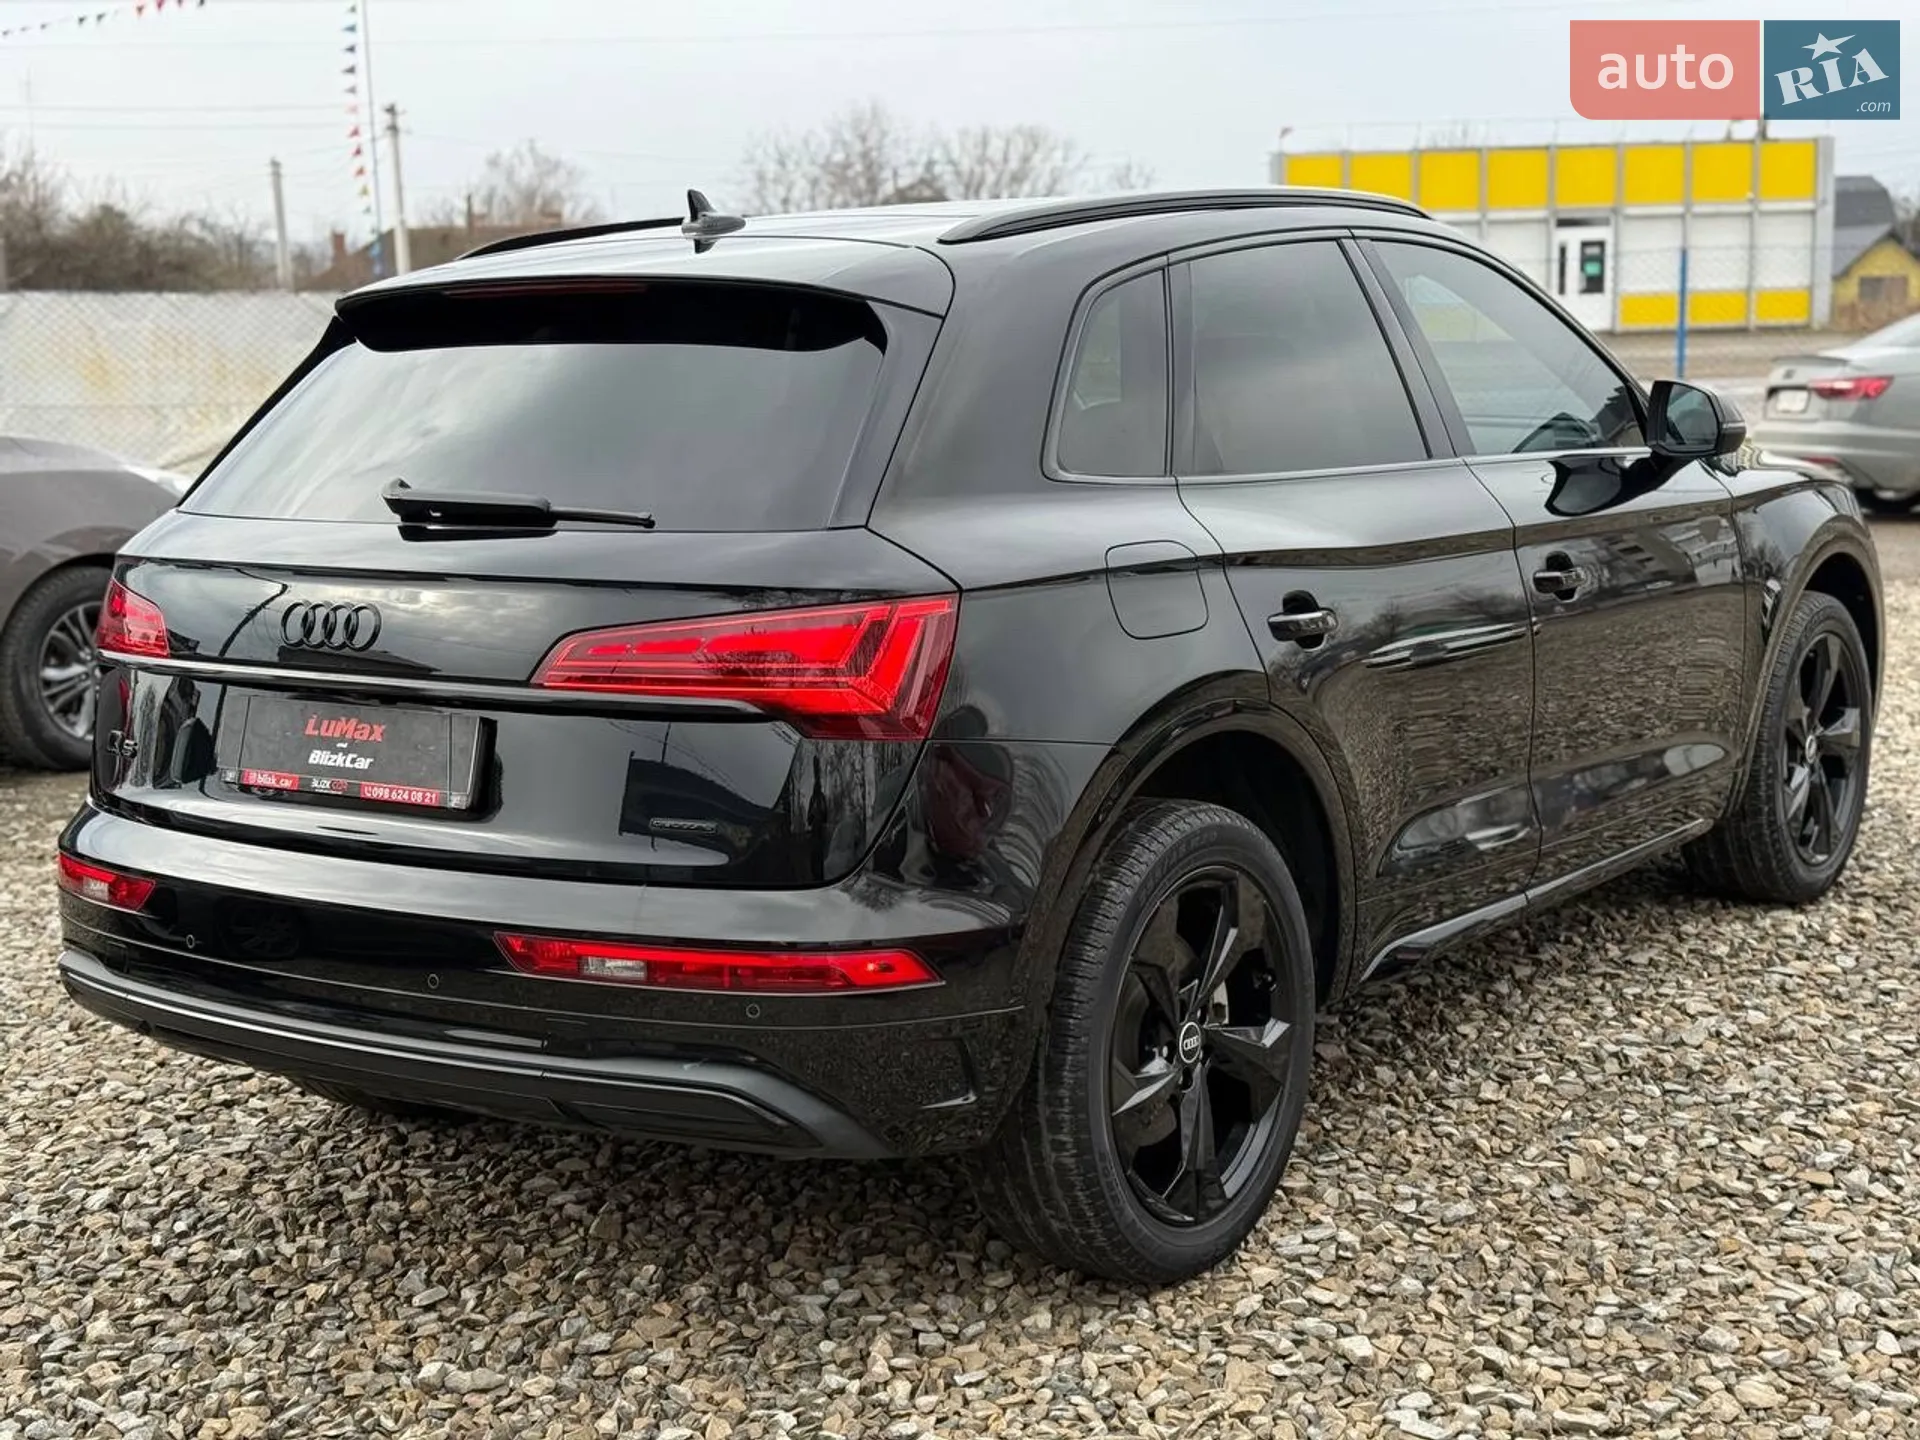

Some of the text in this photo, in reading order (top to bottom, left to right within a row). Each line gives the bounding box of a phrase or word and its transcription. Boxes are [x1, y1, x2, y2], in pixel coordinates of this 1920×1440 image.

[305, 713, 386, 742] LuMax
[372, 786, 437, 805] 098 624 08 21
